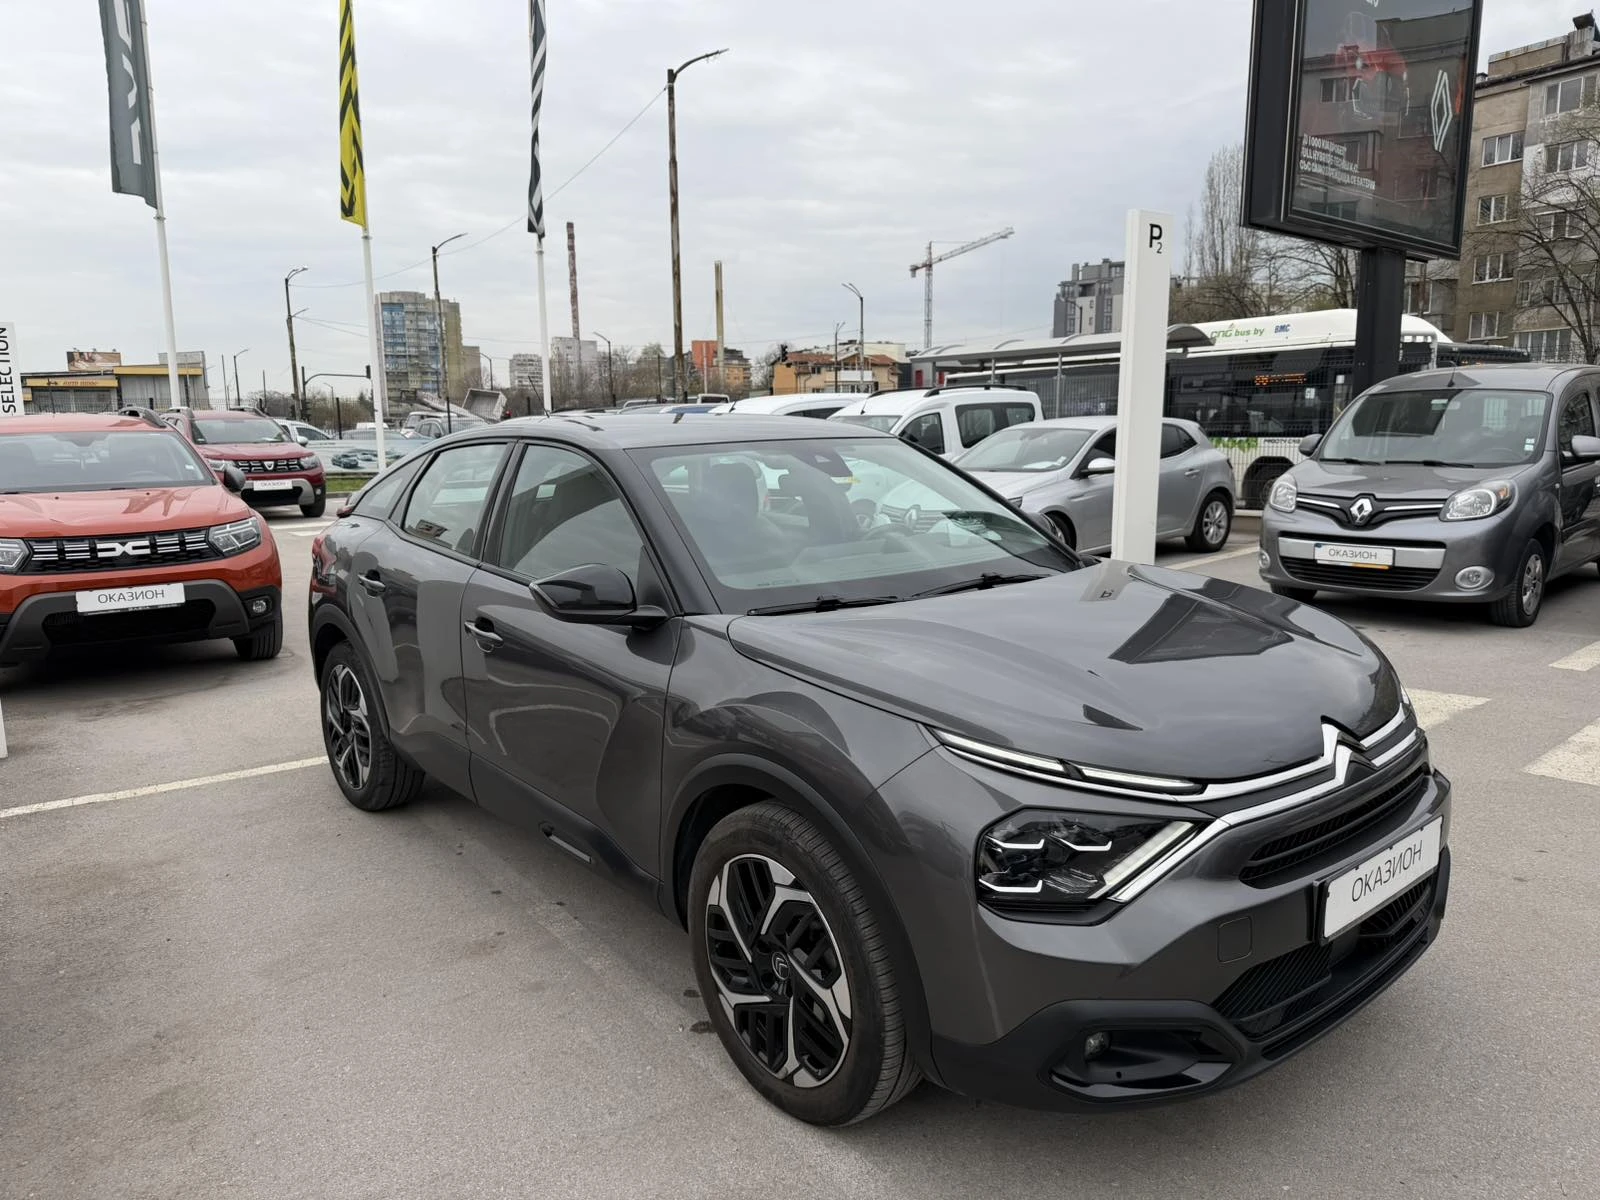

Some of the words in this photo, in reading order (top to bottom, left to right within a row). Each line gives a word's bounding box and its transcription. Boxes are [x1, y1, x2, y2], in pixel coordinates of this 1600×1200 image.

[1234, 328, 1251, 337] bus
[1253, 327, 1265, 337] by
[1328, 548, 1377, 560] ОКАЗИОН
[97, 589, 165, 604] ОКАЗИОН
[1351, 839, 1423, 902] ОКАЗИОН
